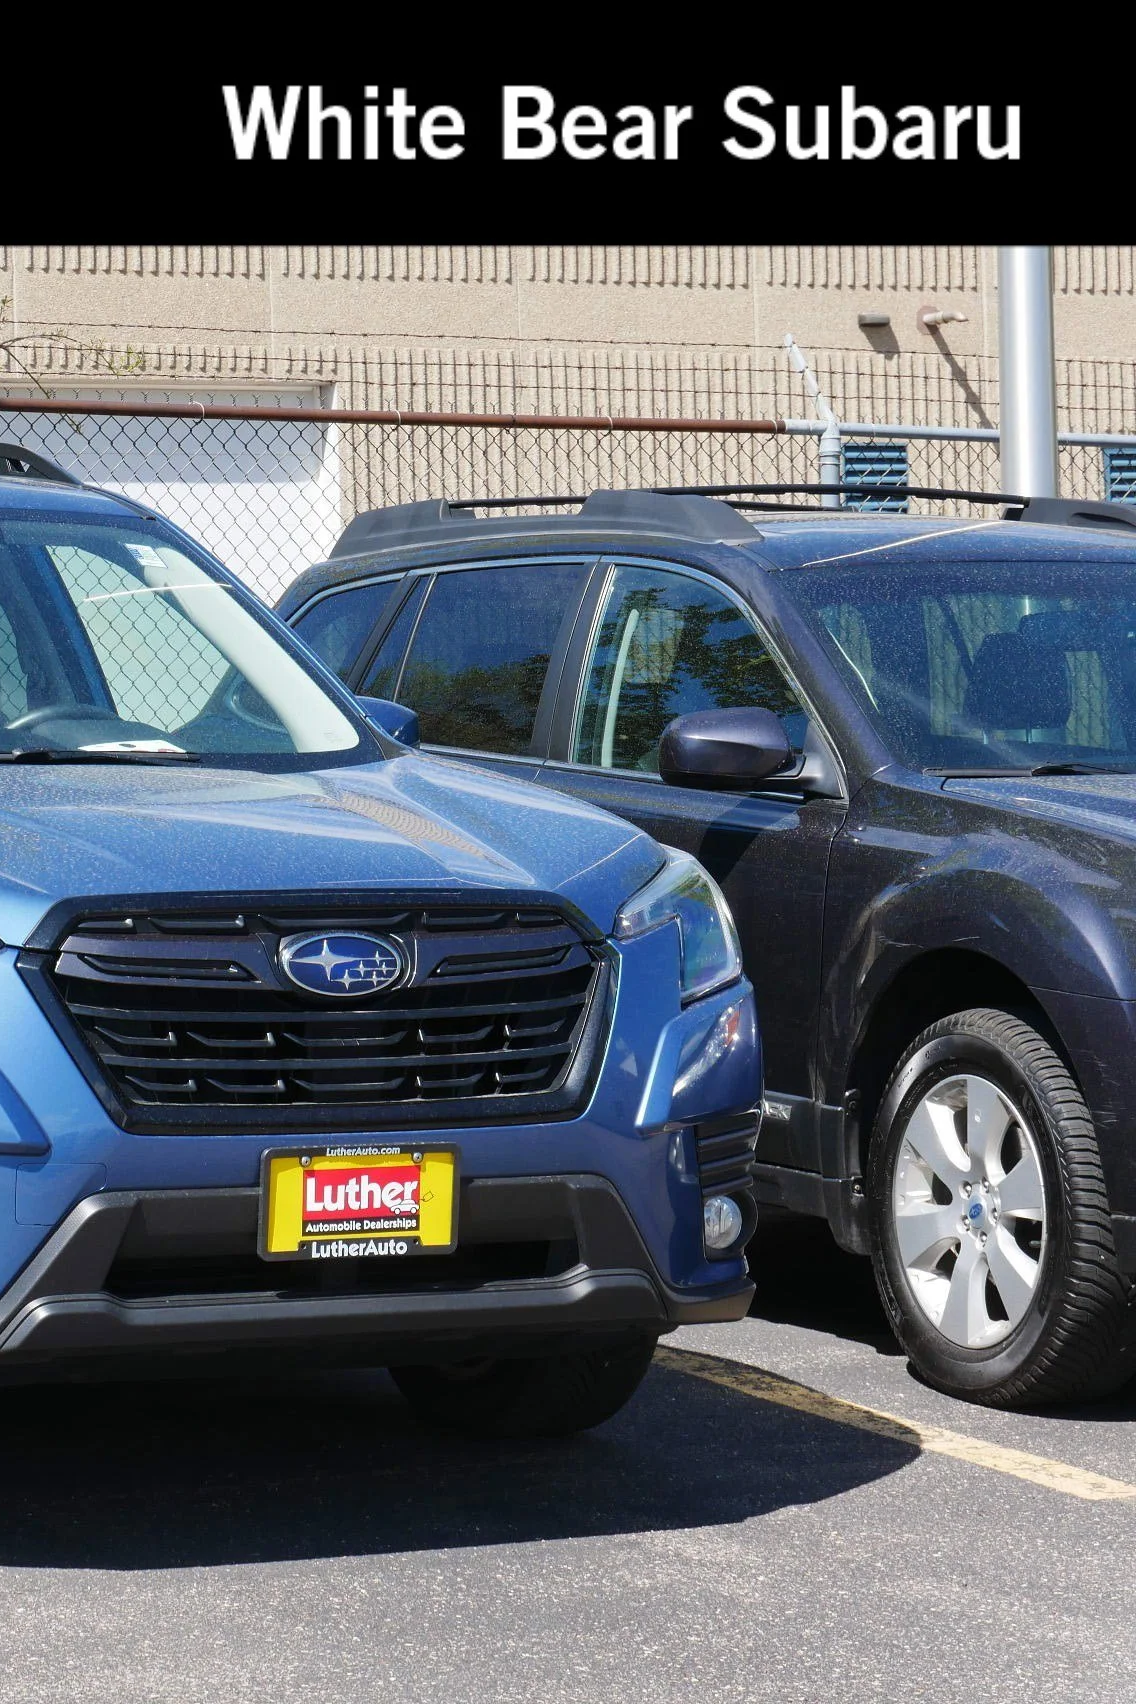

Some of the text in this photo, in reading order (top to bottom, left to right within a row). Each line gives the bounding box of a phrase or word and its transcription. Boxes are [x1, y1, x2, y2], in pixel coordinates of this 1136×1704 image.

[326, 1146, 401, 1157] LutherAuto.com
[305, 1174, 419, 1212] Luther
[305, 1218, 417, 1233] Automobile Dealerships
[311, 1239, 408, 1259] LutherAuto
